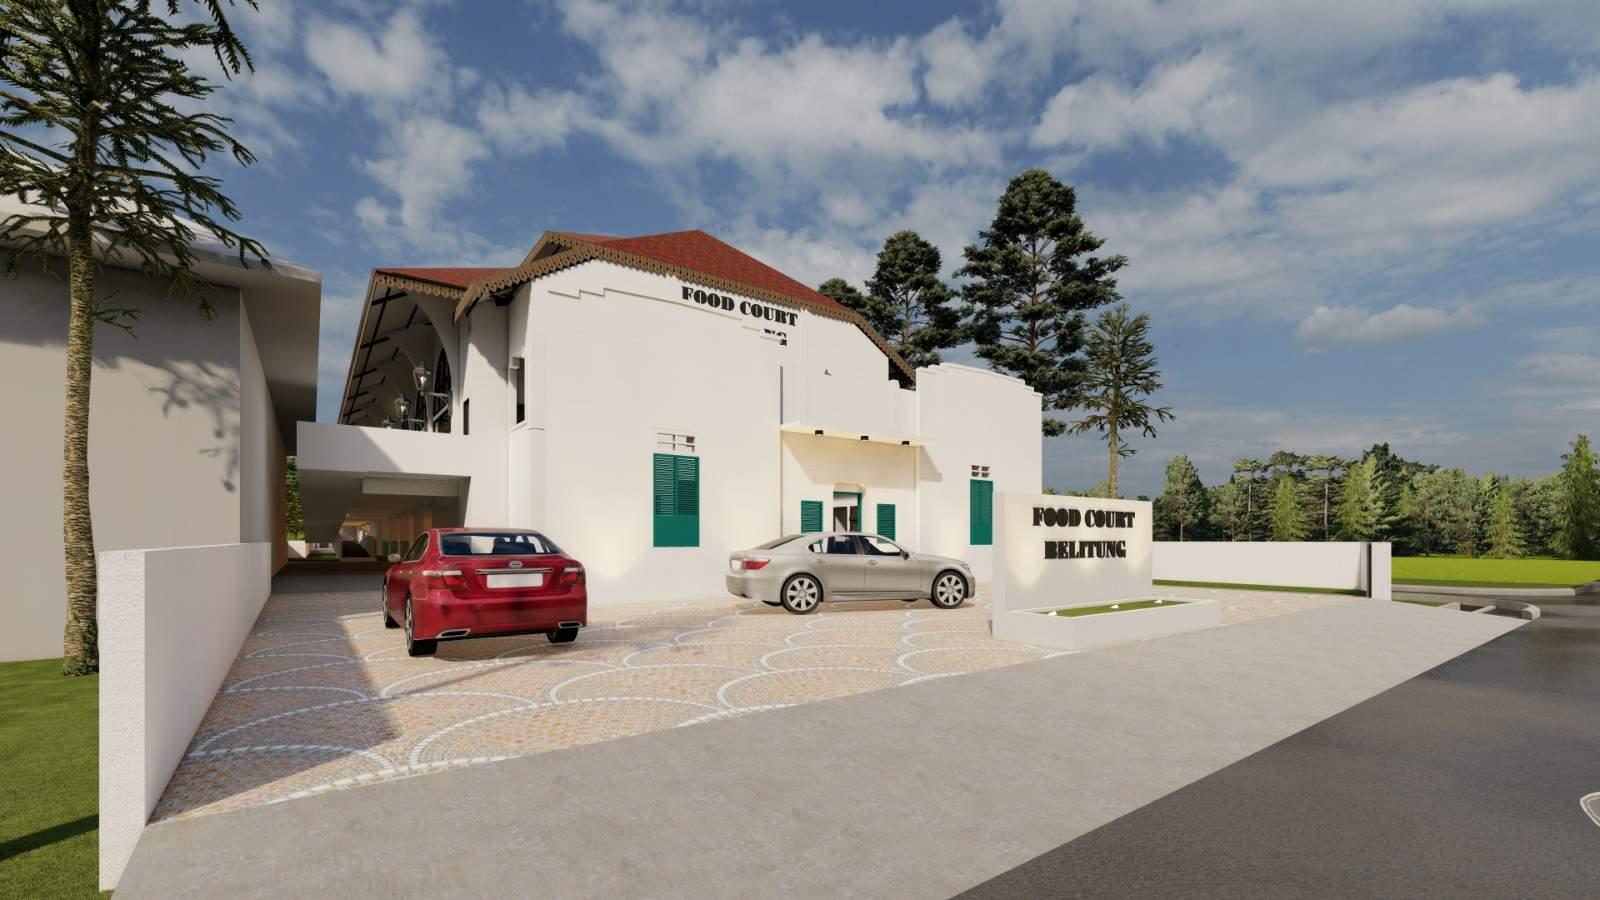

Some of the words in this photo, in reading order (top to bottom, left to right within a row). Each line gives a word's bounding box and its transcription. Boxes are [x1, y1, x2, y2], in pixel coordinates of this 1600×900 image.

[681, 286, 735, 311] FOOD
[739, 301, 798, 326] COURT
[1032, 507, 1081, 527] FOOD
[1084, 509, 1136, 528] COURT
[1044, 540, 1127, 560] BELITUNG
